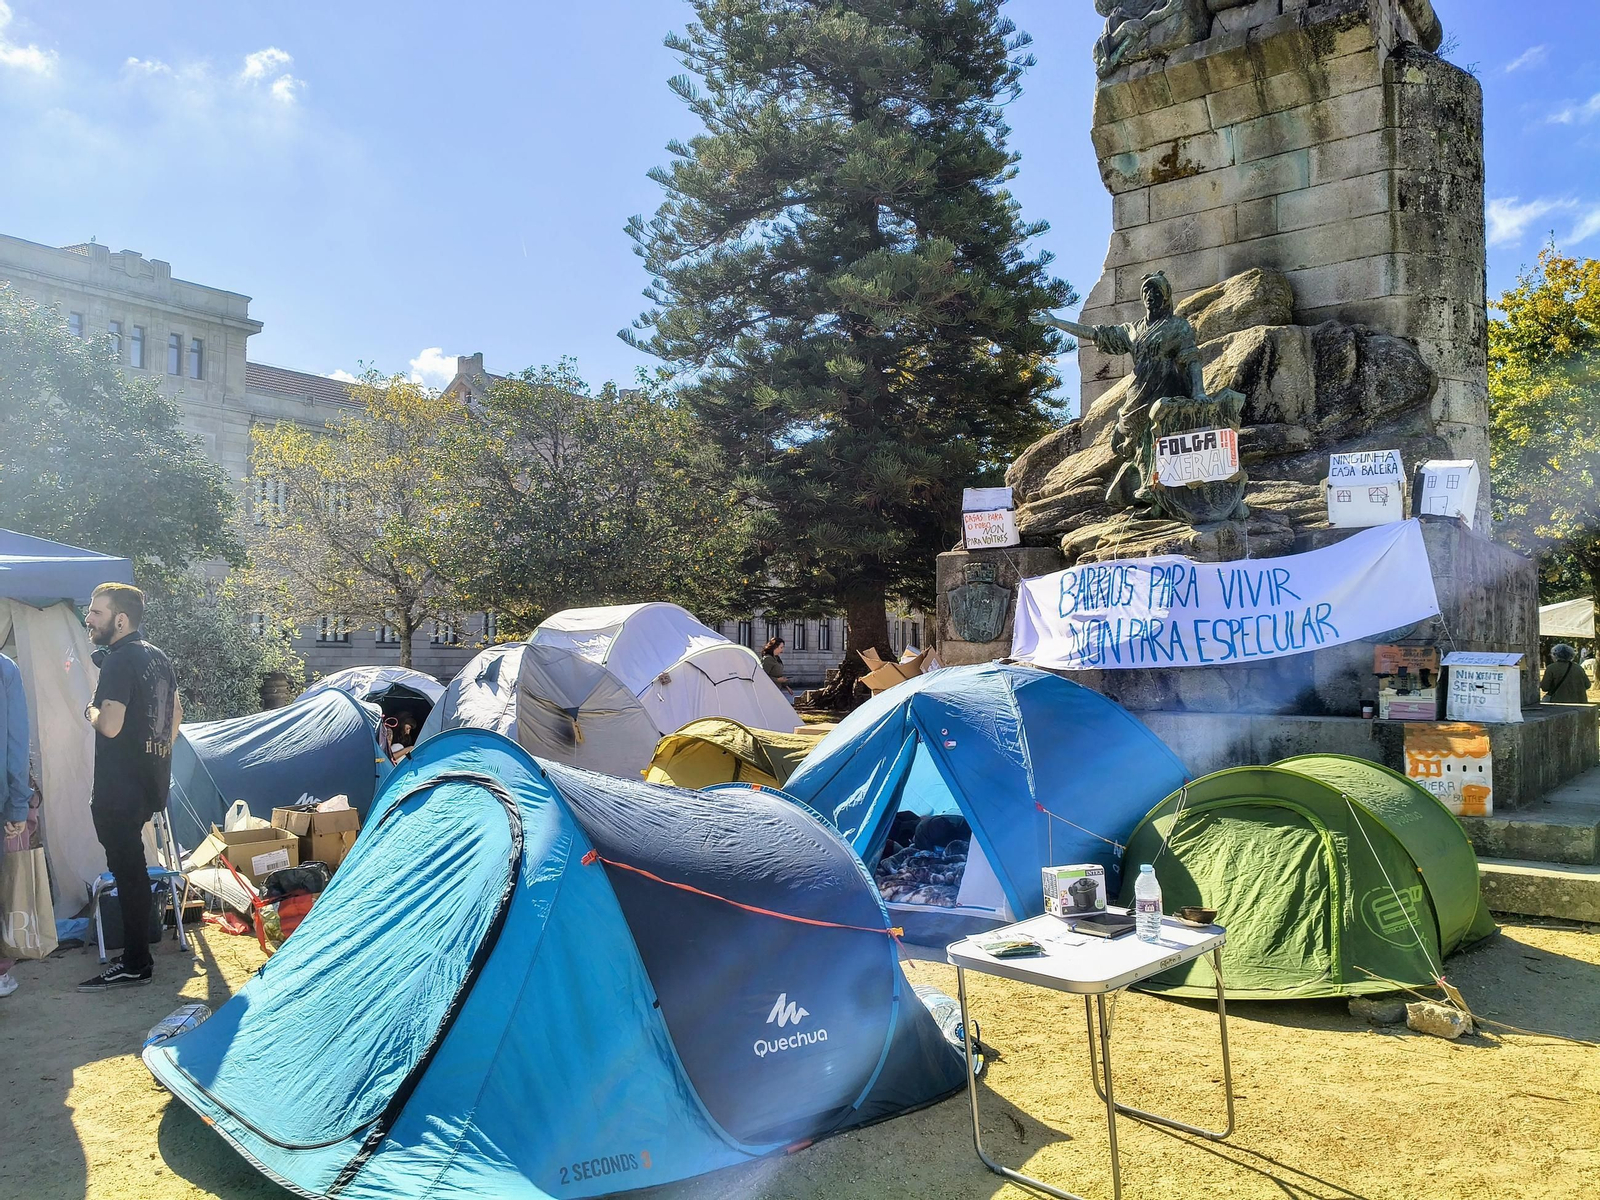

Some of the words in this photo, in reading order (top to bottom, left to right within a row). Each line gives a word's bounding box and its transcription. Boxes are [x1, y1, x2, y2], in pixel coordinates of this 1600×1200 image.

[1158, 449, 1237, 482] XERAL
[1332, 452, 1396, 466] NINGUNHA
[1331, 465, 1356, 477] CASA
[983, 523, 1005, 535] NON
[967, 537, 982, 546] PARA
[1148, 564, 1199, 609] PARA
[1217, 567, 1302, 609] VIVIR
[1067, 618, 1121, 666] NON
[1128, 618, 1189, 663] PARA
[1193, 602, 1340, 663] ESPECULAR
[1453, 681, 1476, 692] SEN
[1453, 692, 1486, 704] TEITO
[753, 1028, 828, 1058] Quechua
[559, 1166, 570, 1185] 2
[572, 1153, 639, 1182] SECONDS
